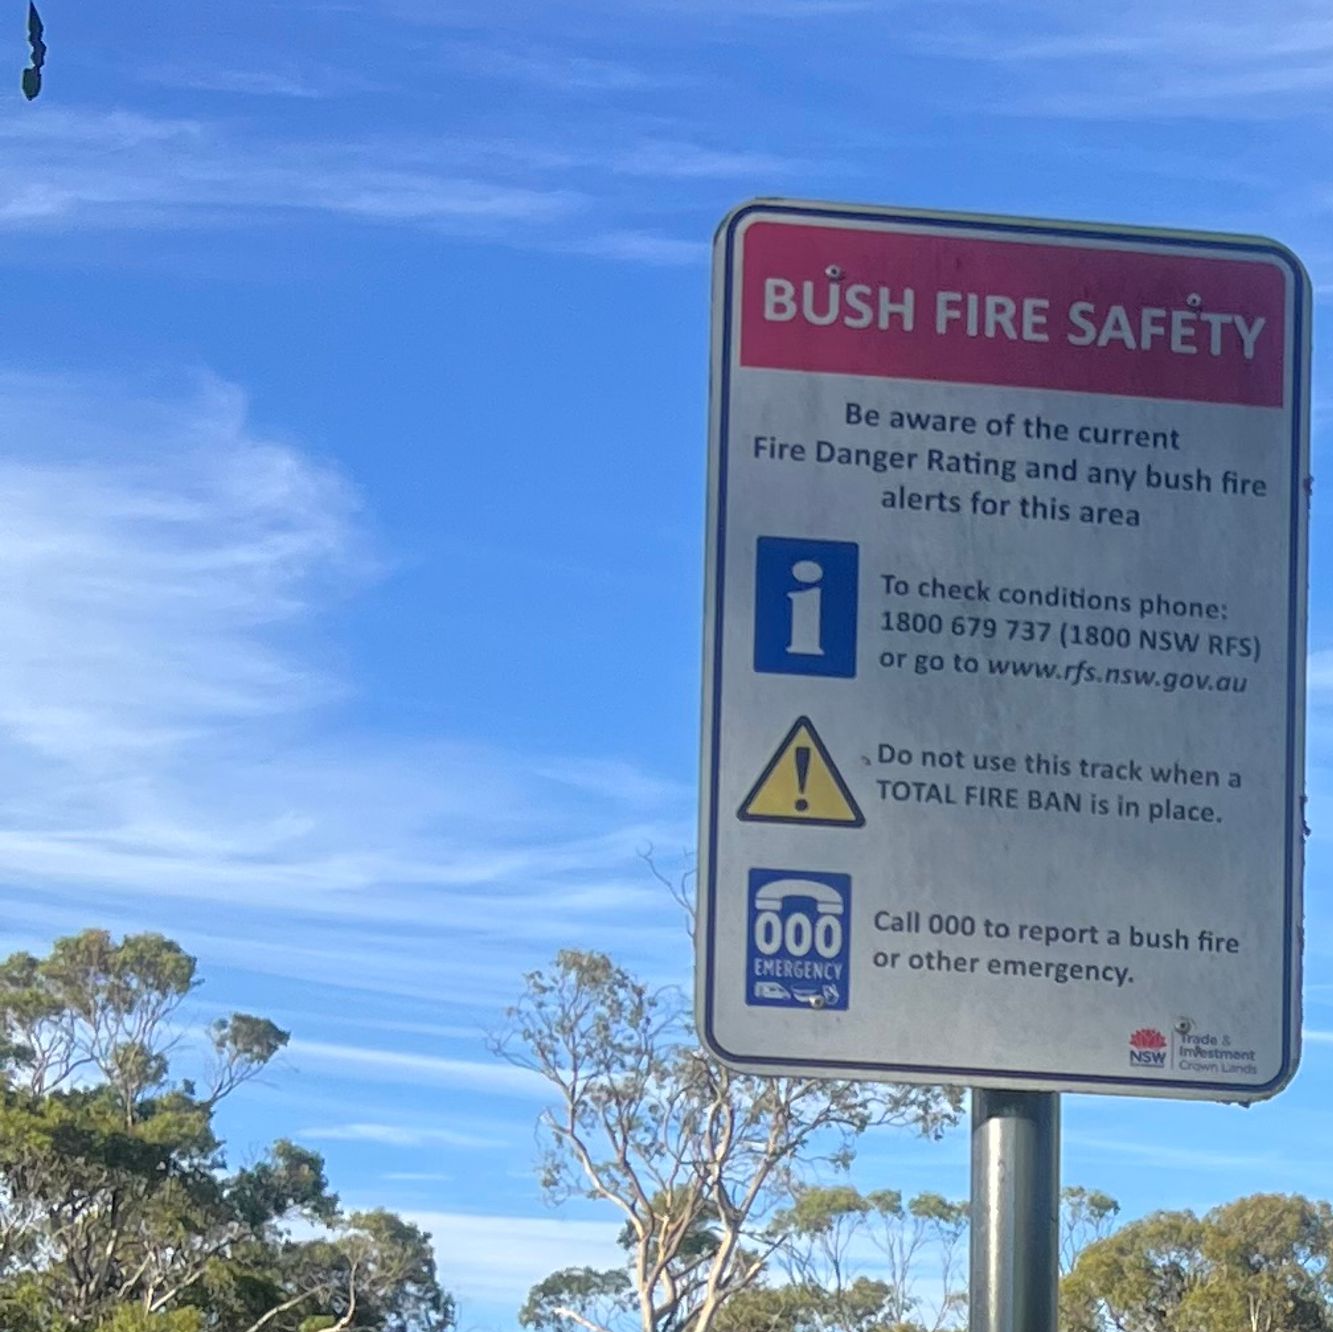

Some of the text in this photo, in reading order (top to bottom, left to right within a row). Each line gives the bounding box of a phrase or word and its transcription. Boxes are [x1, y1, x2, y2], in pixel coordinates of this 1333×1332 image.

[764, 278, 1266, 359] BUSH FIRE SAFETY
[846, 403, 1179, 450] Be aware of the current
[754, 437, 1266, 496] Fire Danger Rating and any bush fire
[882, 485, 1139, 526] alerts for this area
[881, 575, 1227, 620] To check conditions phone:
[882, 611, 1260, 663] 1800 679 737 (1800 NSW RFS)
[880, 652, 1247, 692] or go to www.rfs.nsw.gov.au
[878, 744, 1241, 788] Do not use this track when a
[877, 780, 1221, 823] TOTAL FIRE BAN is in place.
[755, 911, 842, 959] 000
[874, 911, 1239, 953] Call 000 to report a bush fire
[754, 958, 842, 980] EMERGENCY
[873, 950, 1133, 987] or other emergency.
[1130, 1051, 1167, 1064] NSW
[1179, 1046, 1256, 1061] Investment
[1181, 1034, 1217, 1046] Trade
[1179, 1060, 1257, 1075] Crown Lands
